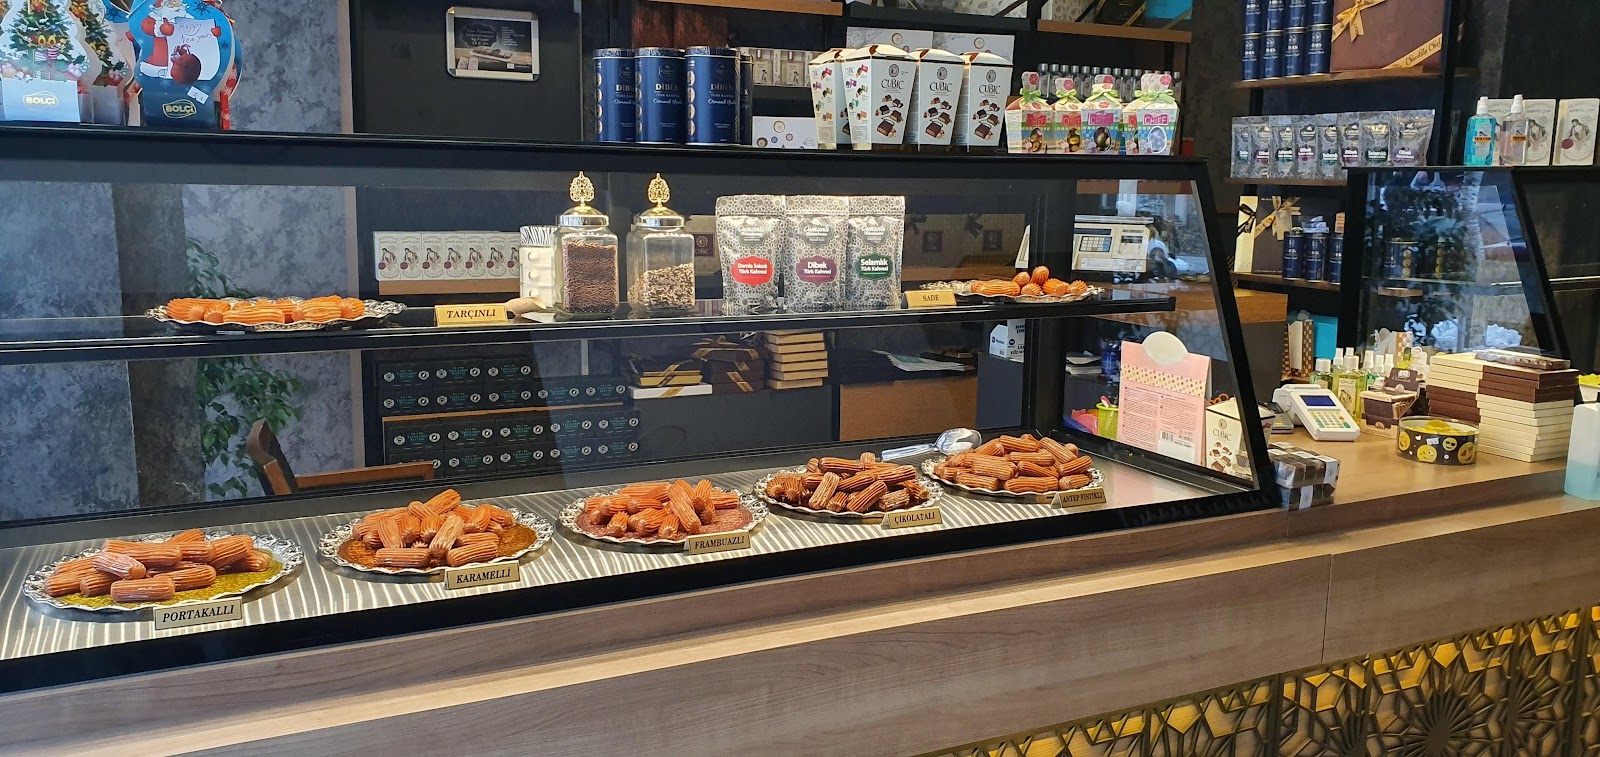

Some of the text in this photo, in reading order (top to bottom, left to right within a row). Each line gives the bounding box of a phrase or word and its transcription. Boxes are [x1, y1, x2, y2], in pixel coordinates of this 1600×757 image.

[880, 78, 905, 90] CUBIC
[929, 81, 953, 93] CUBIC
[978, 84, 1001, 95] CUBIC
[25, 96, 57, 106] BOLÇİ
[165, 104, 194, 114] BOLÇİ
[1144, 115, 1168, 125] CHIEF
[807, 261, 828, 269] Dibek
[860, 257, 888, 266] Selamlık
[446, 308, 496, 320] TARÇINLI
[1212, 428, 1232, 442] CUBIC
[1063, 494, 1080, 503] ANTEP
[694, 535, 746, 550] FRAMBUAZLI
[456, 566, 511, 584] KARAMELLİ
[162, 604, 235, 623] PORTAKALLI
